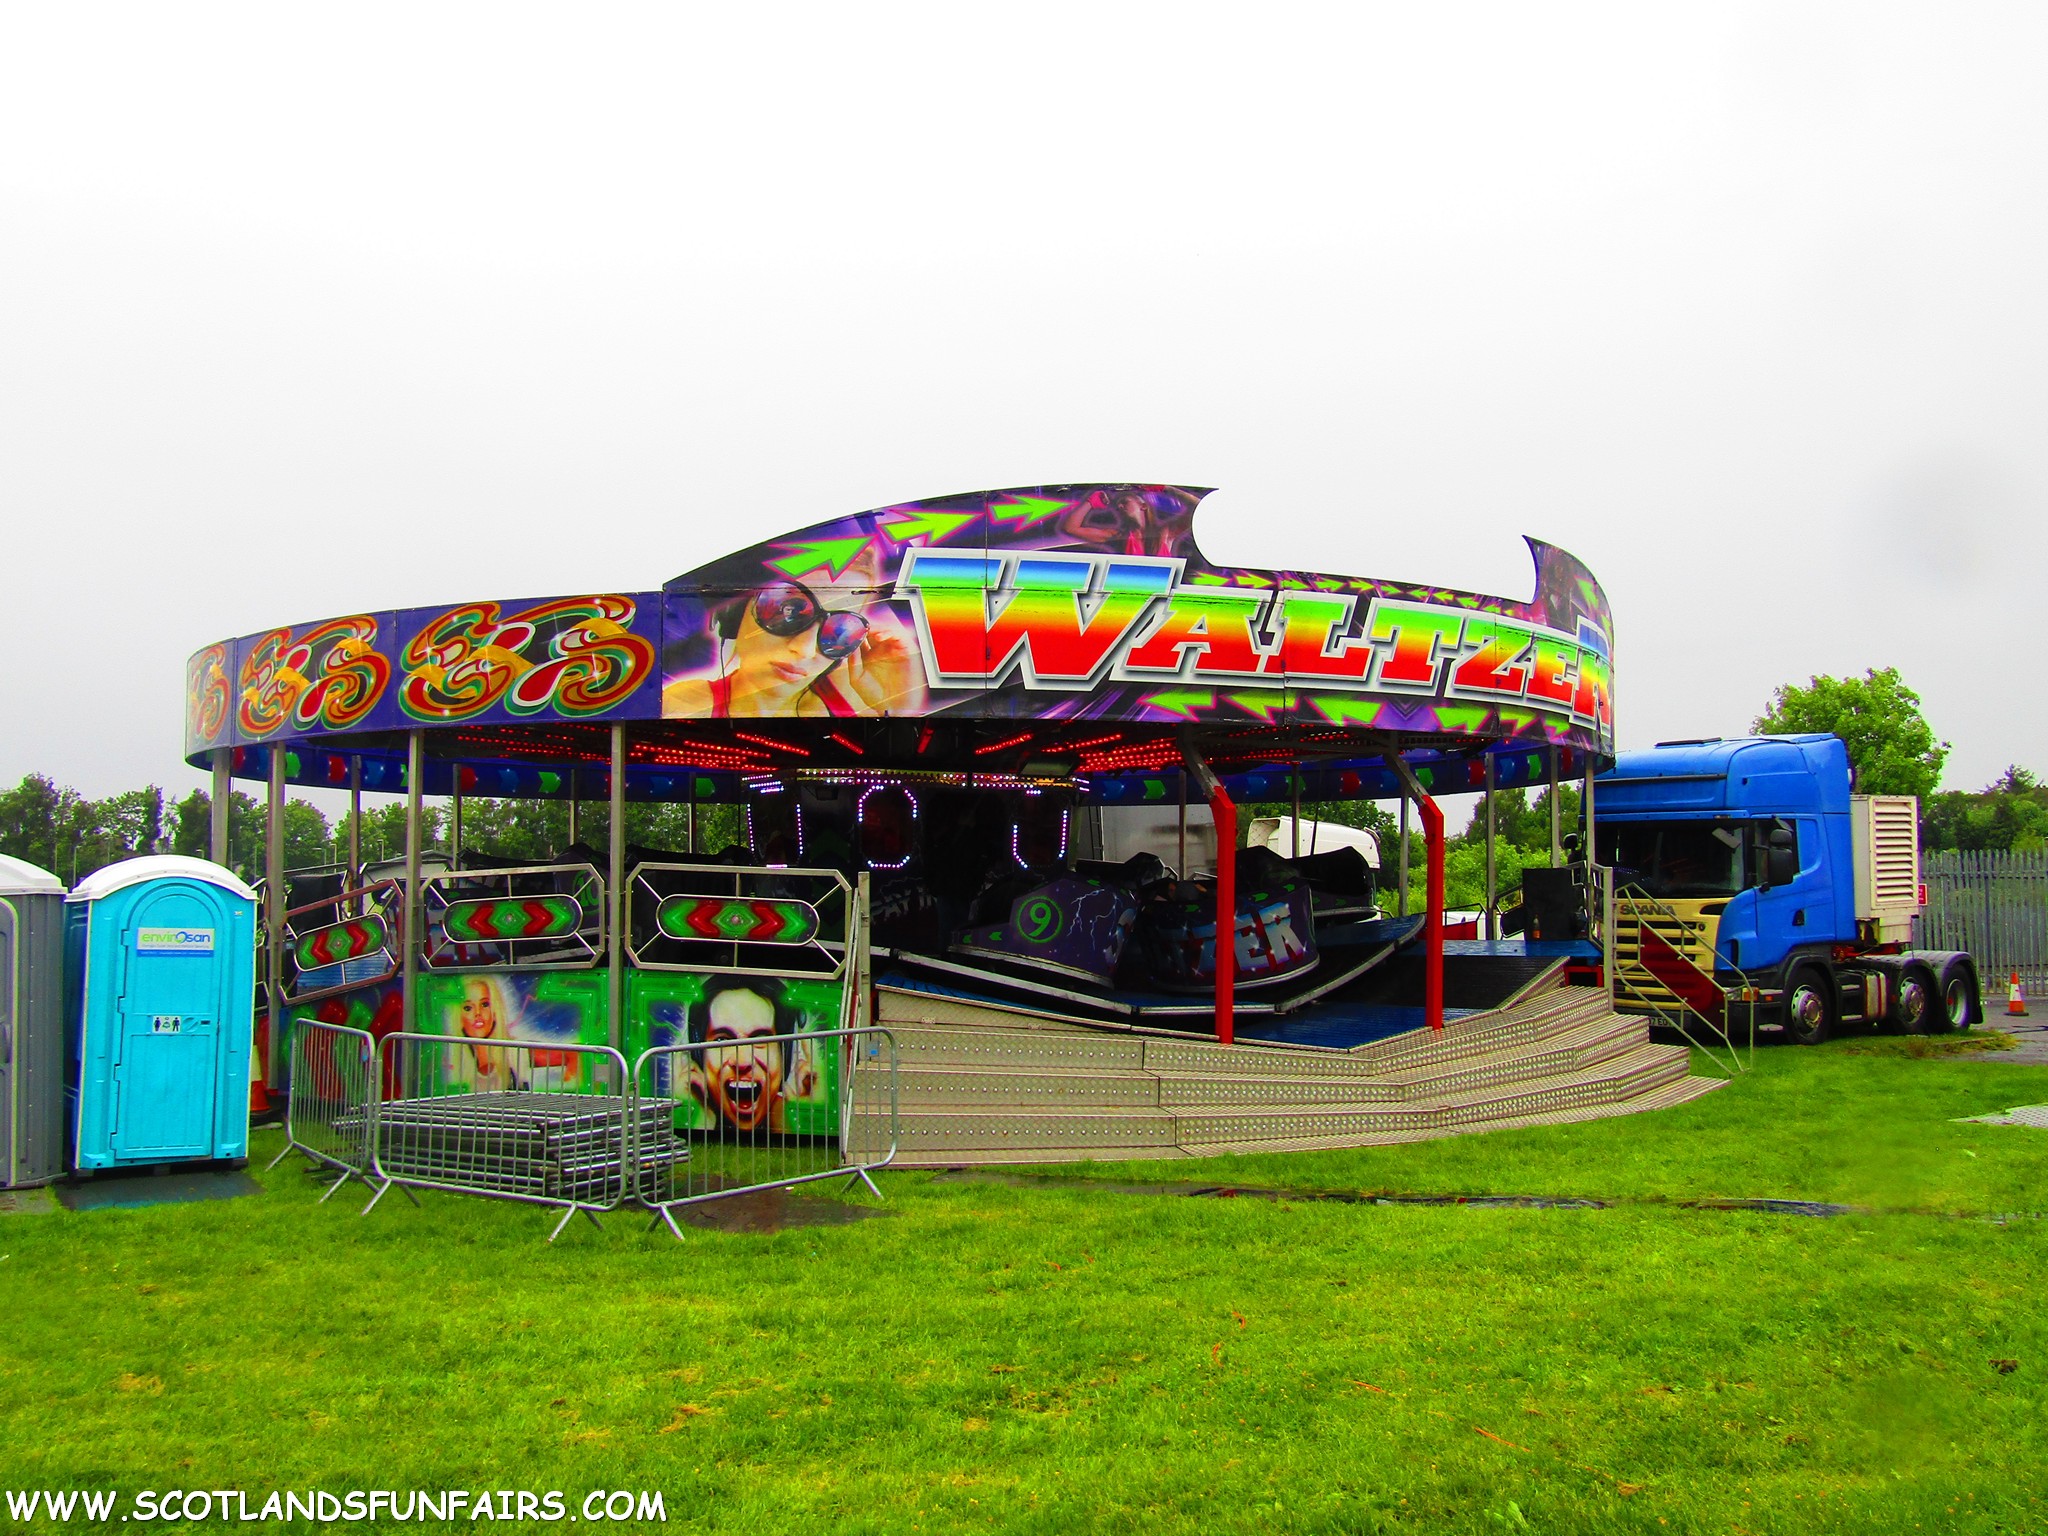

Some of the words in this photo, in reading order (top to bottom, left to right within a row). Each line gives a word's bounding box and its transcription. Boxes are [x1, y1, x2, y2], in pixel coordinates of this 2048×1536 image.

[892, 547, 1612, 738] WALTZER
[1030, 902, 1051, 937] 9
[1620, 904, 1676, 916] SCANIA
